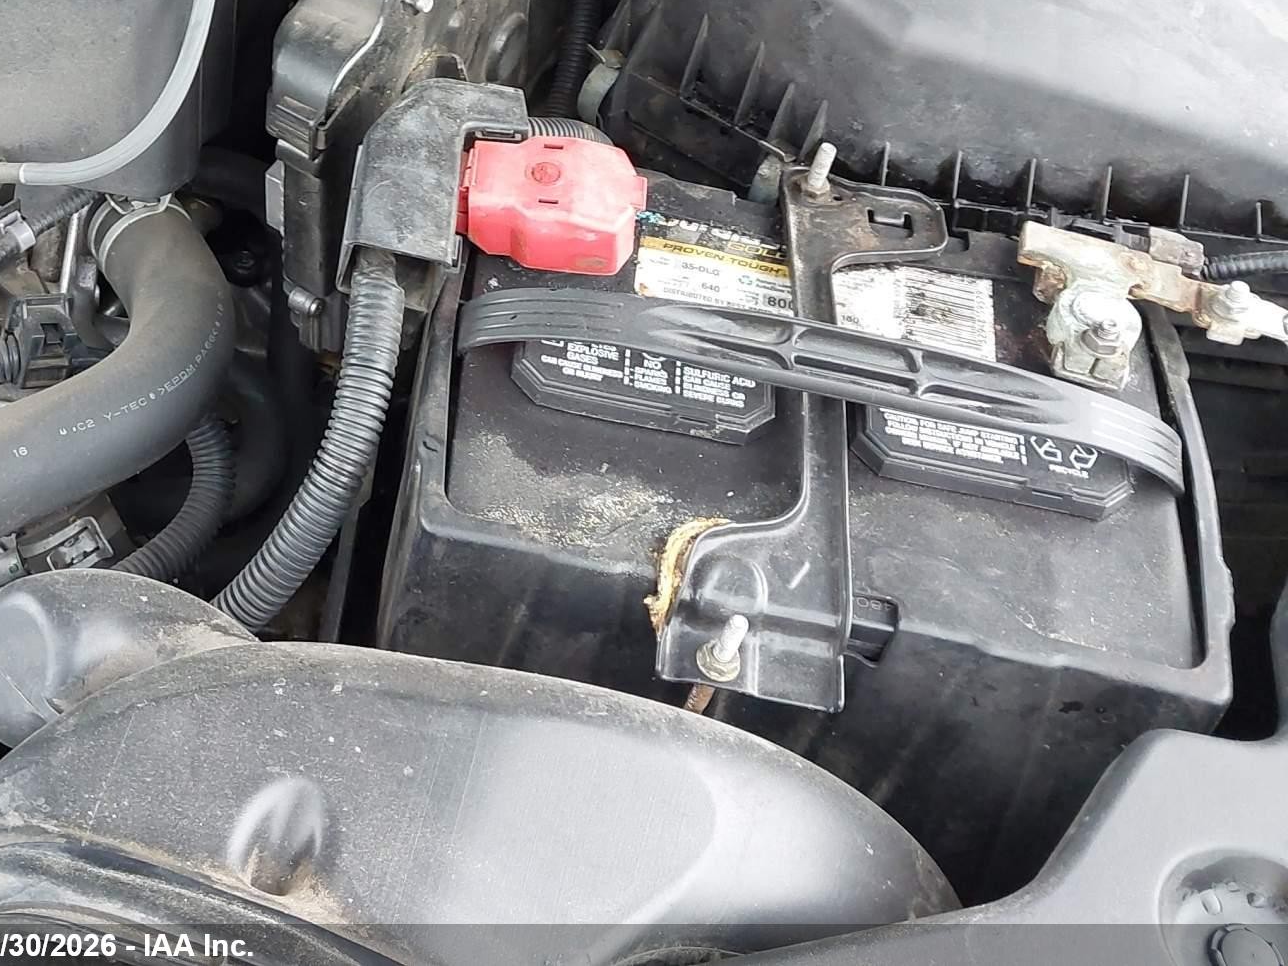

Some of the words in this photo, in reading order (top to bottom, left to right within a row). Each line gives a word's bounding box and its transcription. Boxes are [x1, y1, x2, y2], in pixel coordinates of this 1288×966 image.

[663, 242, 724, 261] PROVEN
[729, 257, 780, 274] TOUGH
[566, 351, 599, 365] GASES
[567, 342, 619, 361] EXPLOSIVE
[643, 359, 662, 370] NO
[683, 366, 731, 383] SULFURIC
[731, 376, 756, 388] ACID
[103, 396, 148, 422] Y-TEC
[12, 446, 29, 459] 16
